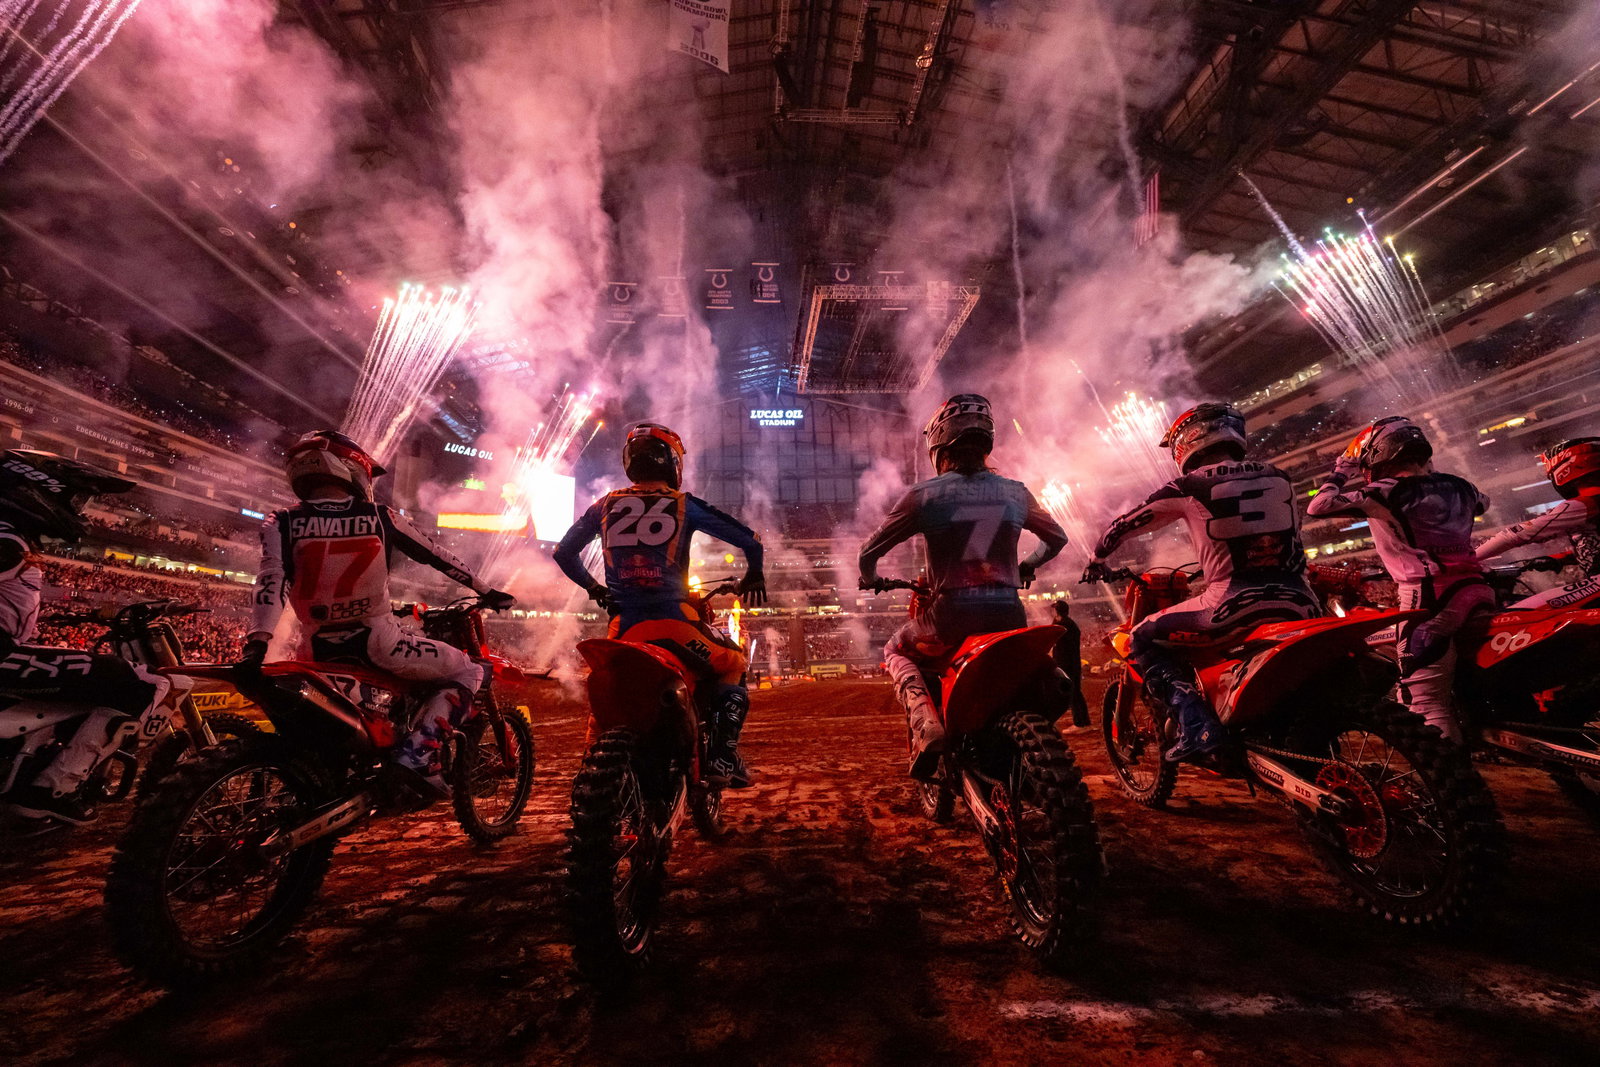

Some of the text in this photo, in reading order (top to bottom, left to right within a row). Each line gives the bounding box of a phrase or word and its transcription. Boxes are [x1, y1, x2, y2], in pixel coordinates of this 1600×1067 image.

[674, 2, 727, 22] CHAMPIONS
[704, 6, 729, 16] BOWL
[680, 42, 720, 66] 2006
[4, 399, 34, 414] 1996-08
[750, 409, 804, 419] LUCAS OIL
[109, 438, 129, 450] JAMES
[444, 442, 494, 461] LUCAS OIL
[2, 460, 67, 493] 100%
[1208, 476, 1293, 540] 3
[292, 515, 379, 538] SAVATGY
[606, 497, 677, 547] 26
[950, 505, 1007, 561] 7
[298, 538, 381, 599] 17
[330, 607, 371, 620] LOCK
[331, 598, 370, 612] QUAD
[1490, 626, 1532, 655] 96
